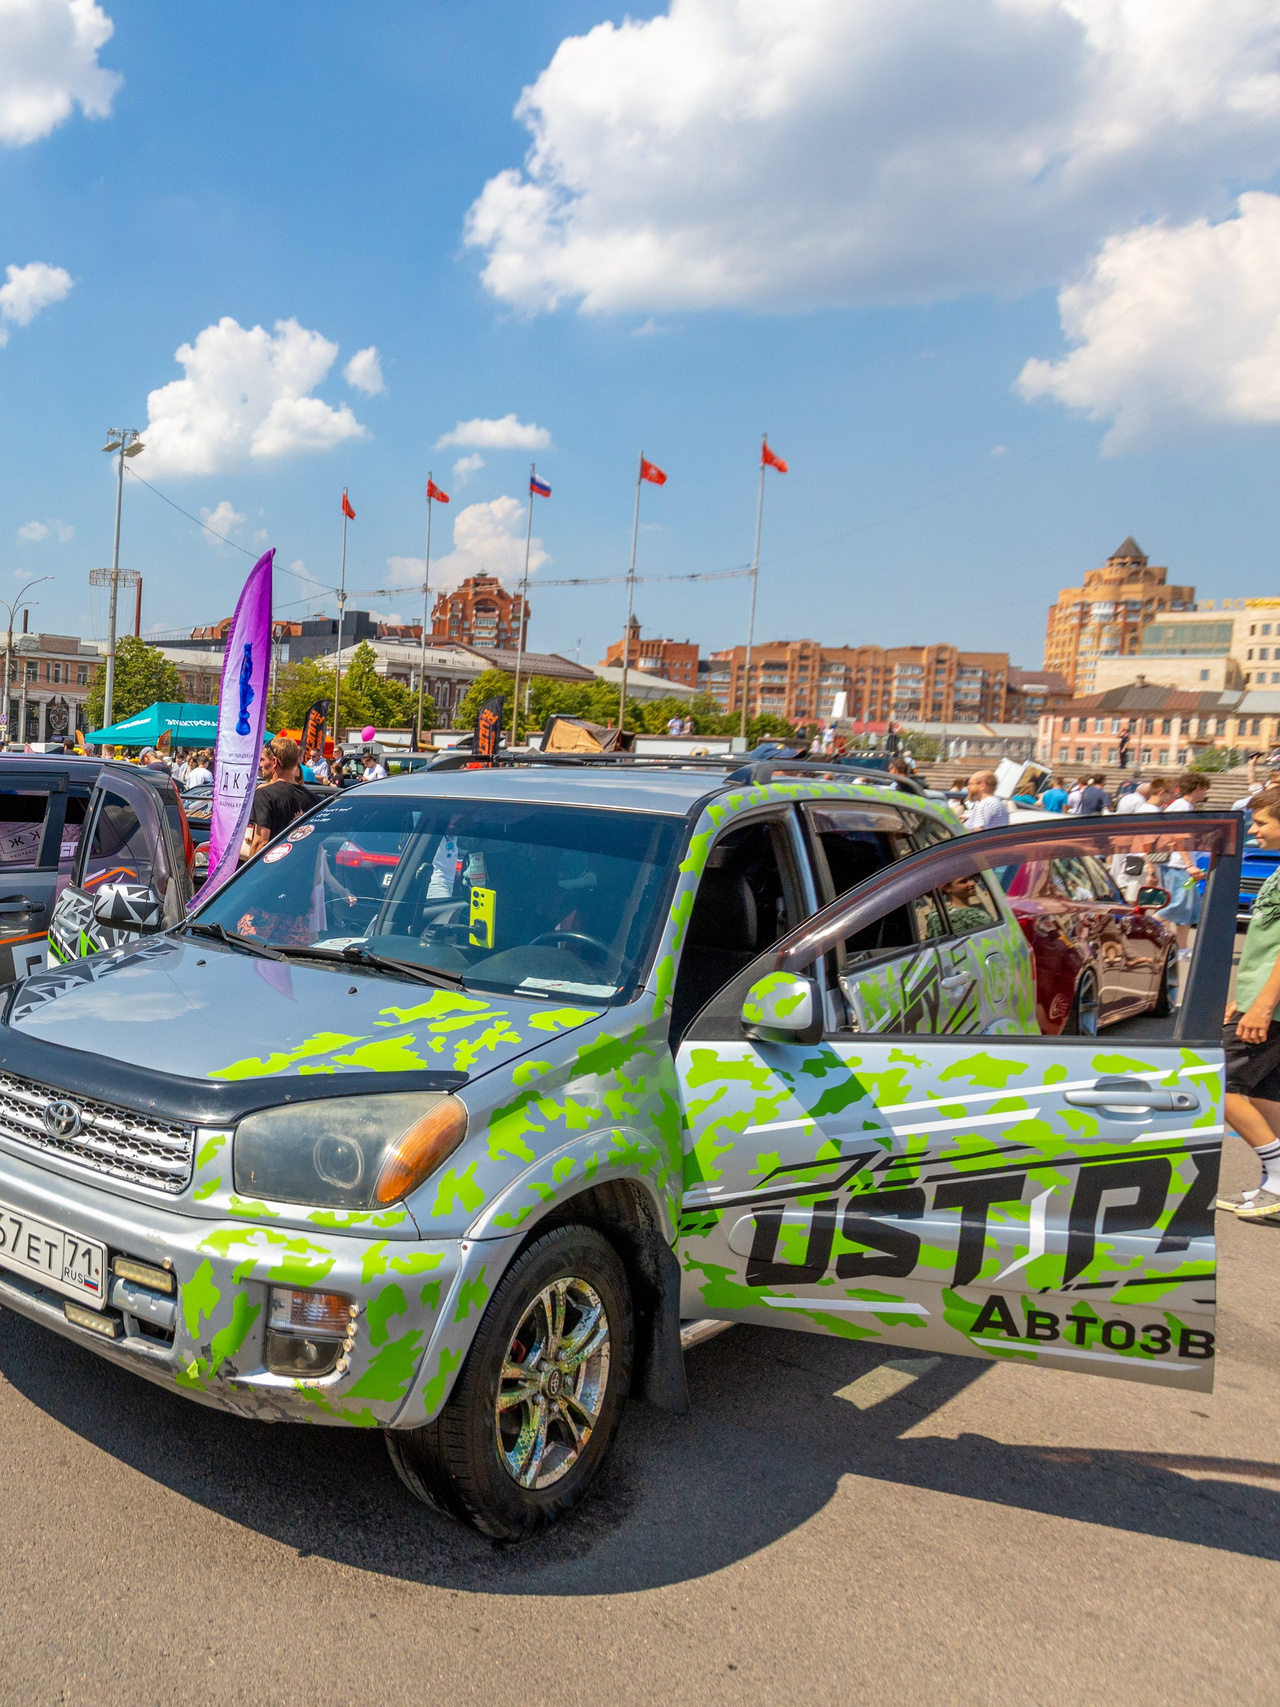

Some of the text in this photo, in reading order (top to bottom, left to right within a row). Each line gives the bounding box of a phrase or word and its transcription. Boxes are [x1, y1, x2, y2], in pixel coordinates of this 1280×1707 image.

[744, 1174, 1029, 1290] UST
[64, 1266, 84, 1285] RUS
[66, 1238, 93, 1277] 71
